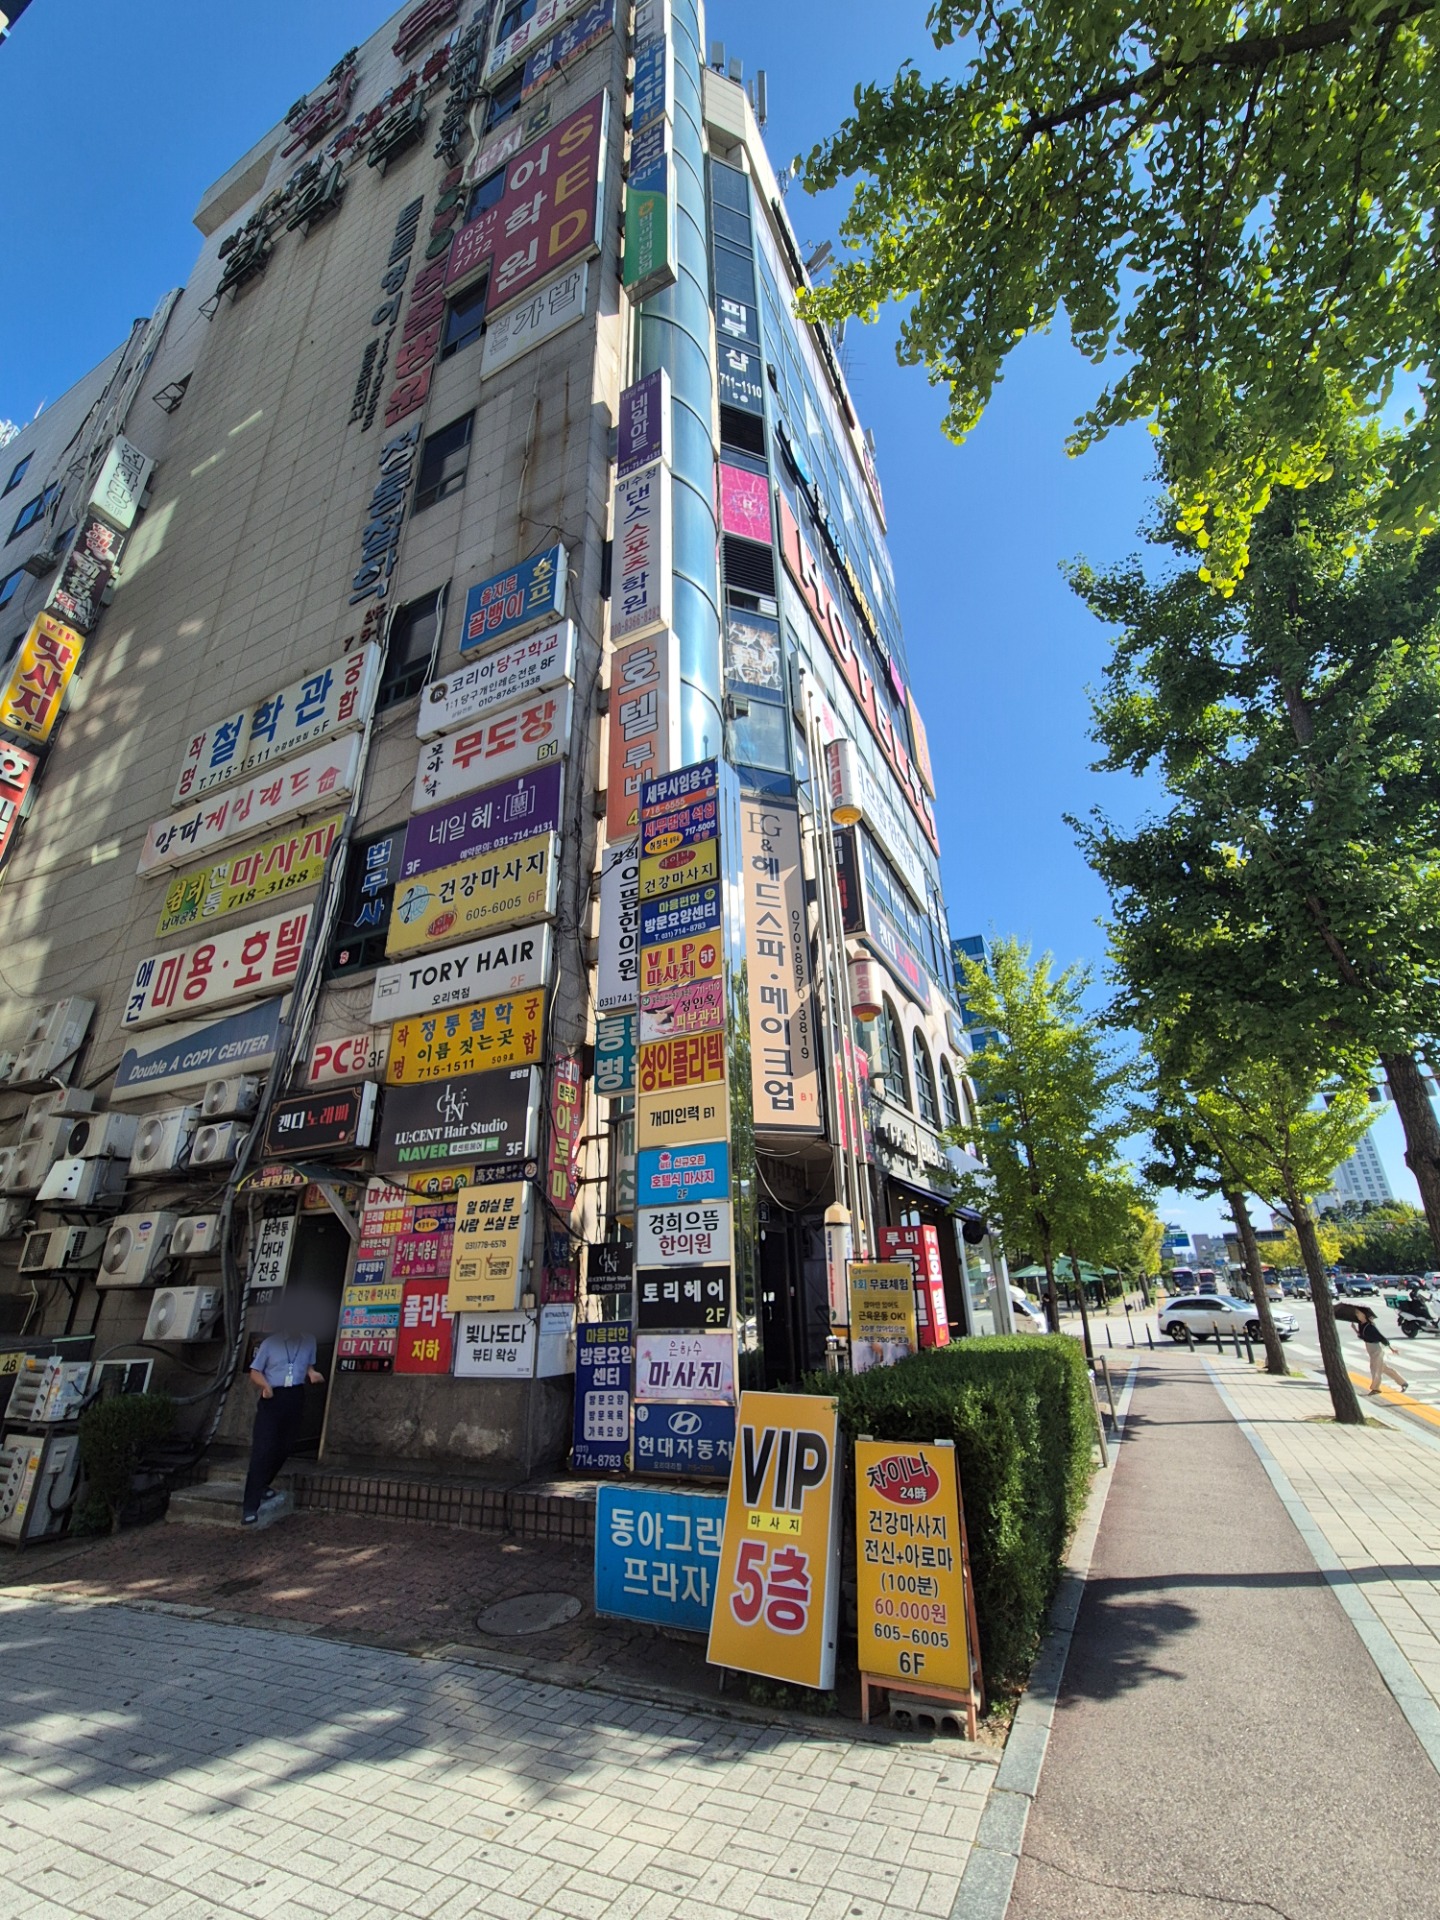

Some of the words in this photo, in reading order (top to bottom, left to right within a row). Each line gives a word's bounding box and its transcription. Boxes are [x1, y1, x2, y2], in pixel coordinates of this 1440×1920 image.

[548, 113, 594, 258] SED
[495, 144, 551, 293] 어학원
[452, 237, 494, 275] 7772
[512, 272, 581, 335] 가발
[720, 372, 762, 399] 711-1110
[629, 392, 650, 454] 네일아트
[106, 442, 146, 511] 전화방
[618, 467, 657, 491] 이수정
[480, 573, 518, 607] 을지로
[527, 556, 553, 610] 호프
[467, 590, 525, 640] 골뱅이
[46, 619, 76, 642] VIP
[540, 654, 556, 671] 8F
[11, 632, 73, 725] 맛사지
[337, 651, 365, 723] 궁합
[478, 674, 541, 709] 010-8765-1338
[209, 667, 334, 769] 철학관
[452, 699, 558, 770] 무도장
[537, 739, 558, 762] B1
[178, 733, 206, 796] 작명
[429, 812, 467, 845] 네일
[644, 810, 690, 838] 세무법인
[692, 801, 716, 822] 석성
[493, 819, 553, 850] 031-714-4131
[229, 822, 337, 890] 마사지
[405, 857, 422, 877] 3F
[201, 862, 230, 917] 전통
[227, 868, 309, 910] 718-3188
[354, 838, 393, 929] 법무사
[438, 850, 546, 904] 건강마사지
[644, 862, 713, 895] 건강마사지
[167, 872, 205, 913] 쉼터
[465, 894, 522, 922] 605-6005
[527, 889, 544, 905] 6F
[658, 892, 701, 915] 마음편한
[617, 864, 639, 982] 으뜸한의원
[644, 900, 717, 934] 방문요양센터
[409, 955, 470, 990] TORY
[476, 939, 535, 974] HAIR
[646, 942, 696, 969] VIP
[700, 949, 715, 963] 5F
[510, 973, 526, 989] 2F
[646, 960, 696, 987] 마사지
[791, 909, 810, 1060] 070-8870-3819
[126, 959, 156, 1023] 애견
[431, 985, 470, 1007] 오리역점
[681, 993, 717, 1013] 정인옥
[420, 1001, 515, 1044] 정통철학
[522, 997, 540, 1056] 궁합
[676, 1006, 721, 1031] 피부관리
[128, 1057, 168, 1082] Double
[169, 1053, 180, 1072] A
[182, 1044, 218, 1070] COPY
[217, 1034, 270, 1061] CENTER
[310, 1035, 370, 1081] PC방
[367, 1050, 385, 1069] 3F
[392, 1025, 410, 1081] 작명
[417, 1041, 452, 1064] 이름
[641, 1032, 724, 1093] 성인콜라텍
[417, 1058, 476, 1079] 715-1511
[801, 1092, 814, 1103] B1
[277, 1110, 306, 1133] 캔디
[650, 1105, 700, 1128] 개미인력
[703, 1106, 715, 1119] B1
[395, 1127, 444, 1146] LU:CENT
[443, 1123, 470, 1140] Hair
[469, 1118, 508, 1135] Studio
[397, 1141, 449, 1164] NAVER
[505, 1141, 524, 1158] 3F
[551, 1103, 573, 1202] 아로마
[673, 1153, 706, 1168] 신규오픈
[651, 1173, 682, 1189] 호텔식
[684, 1168, 716, 1186] 마사지
[367, 1184, 406, 1206] 마사지
[466, 1199, 479, 1215] 일
[479, 1197, 502, 1215] 하실
[504, 1196, 515, 1212] 분
[677, 1188, 689, 1200] 2F
[457, 1218, 480, 1234] 사람
[484, 1215, 507, 1234] 쓰실
[508, 1214, 520, 1231] 분
[649, 1210, 720, 1236] 경희으뜸
[261, 1240, 284, 1258] 대대
[659, 1232, 712, 1257] 한의원
[885, 1230, 919, 1247] 루비
[257, 1260, 280, 1283] 전용
[852, 1279, 867, 1292] 1회
[869, 1278, 909, 1292] 무료체험
[642, 1278, 725, 1304] 토리헤어
[705, 1307, 726, 1323] 2F
[890, 1311, 906, 1321] OK!
[342, 1340, 393, 1355] 마사지
[466, 1323, 526, 1345] 빛나도다
[586, 1326, 629, 1344] 마음편한
[411, 1338, 440, 1361] 지하
[472, 1348, 493, 1363] 뷰티
[496, 1347, 517, 1362] 왁싱
[669, 1340, 702, 1357] 은하수
[593, 1366, 620, 1387] 센터
[649, 1361, 722, 1389] 마사지
[588, 1394, 624, 1406] 방문요양
[588, 1410, 624, 1421] 방문목욕
[588, 1426, 624, 1437] 가족요양
[575, 1454, 622, 1468] 714-8783
[638, 1436, 734, 1461] 현대자동차
[742, 1426, 829, 1512] VIP
[866, 1451, 930, 1490] 차이나
[610, 1507, 723, 1557] 동아그린
[750, 1515, 800, 1533] 마사지
[868, 1510, 948, 1540] 건강마사지
[864, 1538, 953, 1572] 전신+아로마
[623, 1557, 711, 1608] 프라자
[731, 1540, 812, 1633] 5층
[880, 1572, 939, 1598] (100분)
[874, 1597, 947, 1625] 60.000원
[873, 1622, 949, 1648] 605-6005
[899, 1651, 925, 1675] 6F
